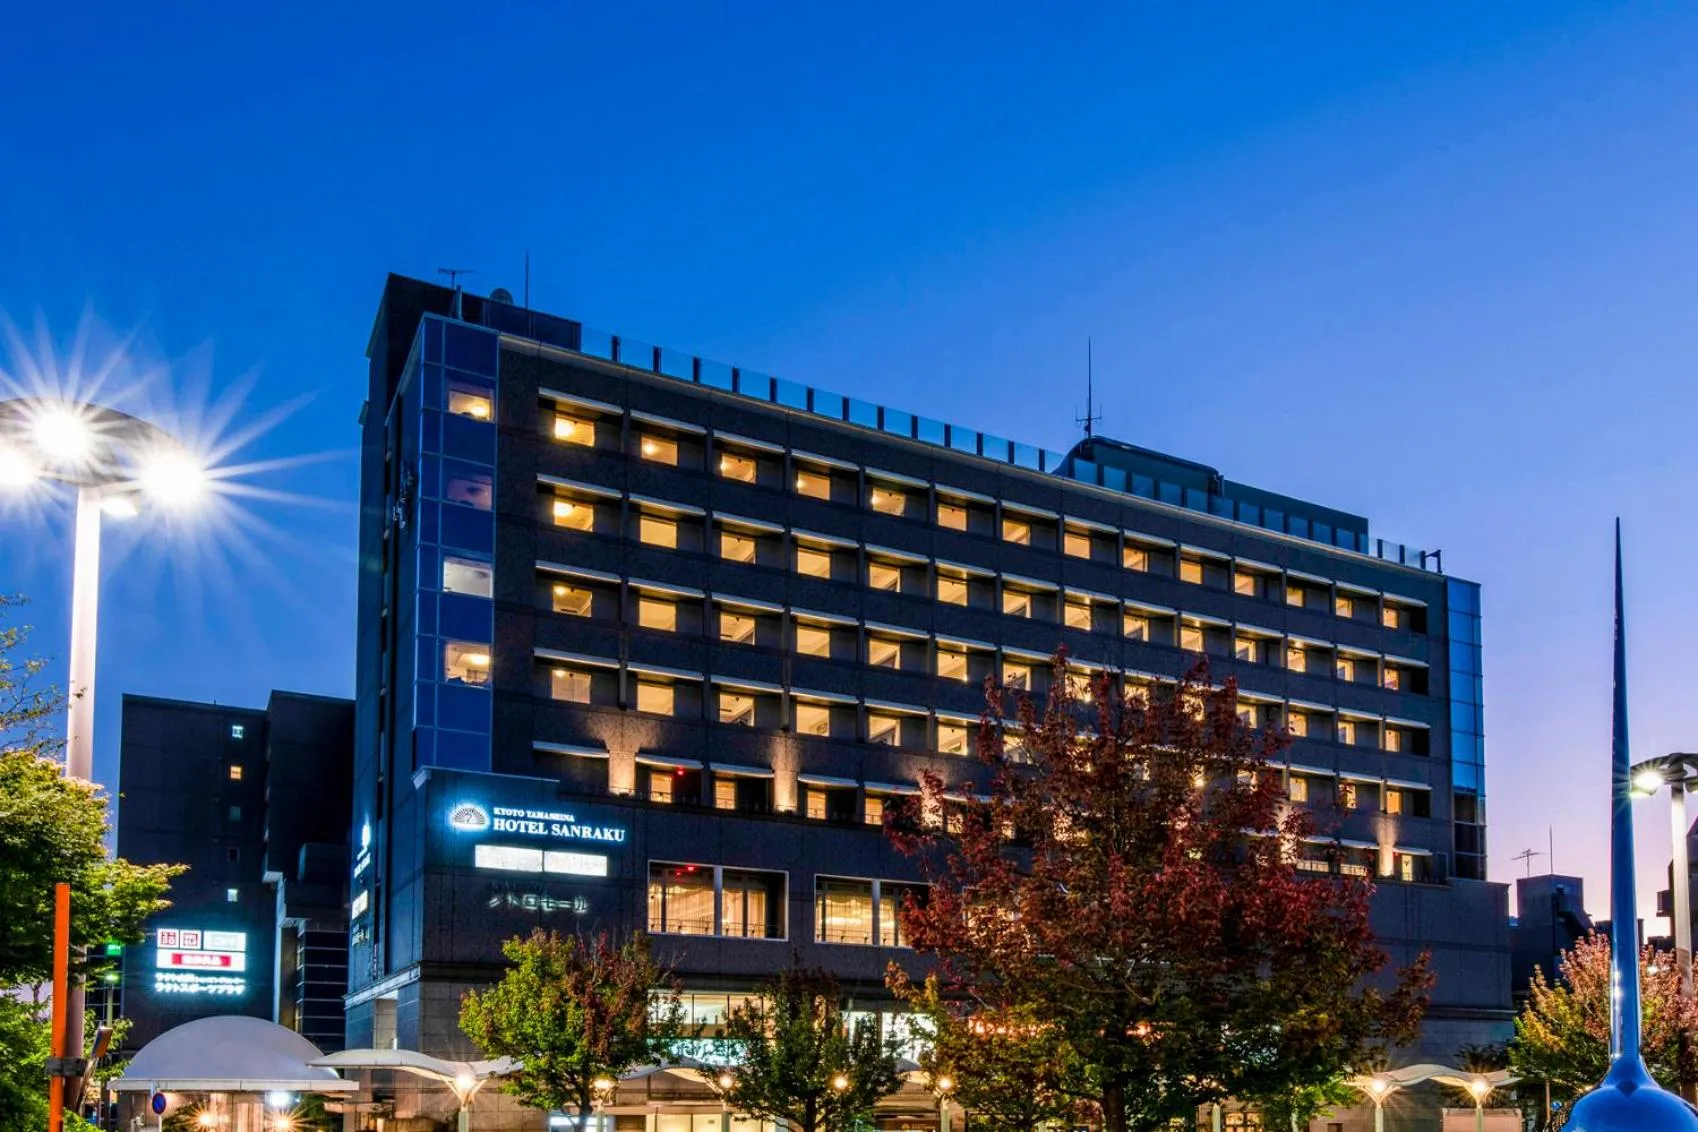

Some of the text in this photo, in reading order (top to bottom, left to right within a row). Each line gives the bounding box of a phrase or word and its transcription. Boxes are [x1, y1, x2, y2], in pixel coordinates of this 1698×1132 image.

[493, 807, 575, 823] KYOTO YAMASHINA
[493, 818, 626, 842] HOTEL SANRAKU
